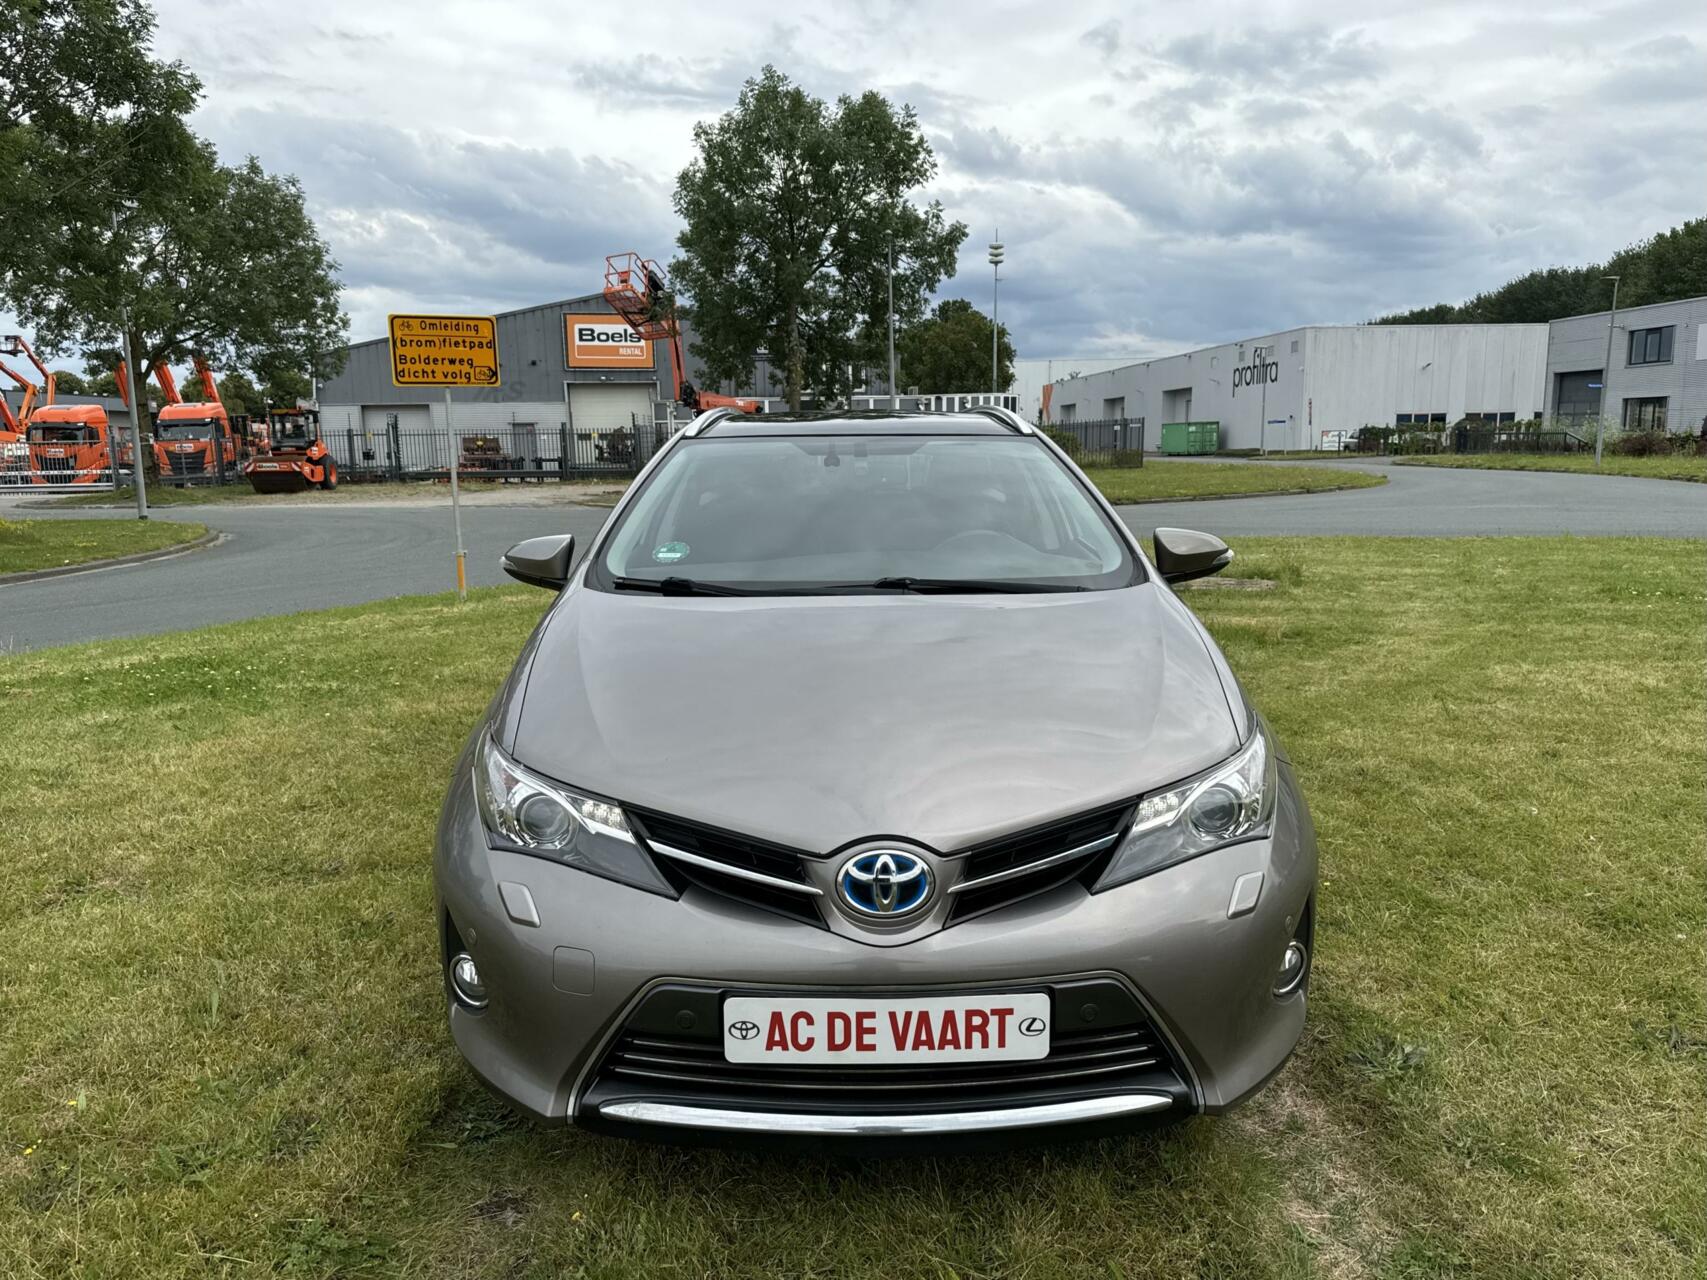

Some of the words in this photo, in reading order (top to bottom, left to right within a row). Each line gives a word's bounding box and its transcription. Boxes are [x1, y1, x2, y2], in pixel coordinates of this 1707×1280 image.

[419, 320, 479, 335] Omleiding
[578, 327, 642, 343] Boels
[618, 347, 642, 356] RENTAL
[398, 354, 474, 368] Bolderweg
[398, 368, 437, 379] dicht
[442, 369, 471, 383] volg
[1232, 348, 1278, 398] profiltra
[765, 1010, 815, 1053] AC
[826, 1010, 877, 1053] DE
[888, 1007, 1015, 1052] VAART
